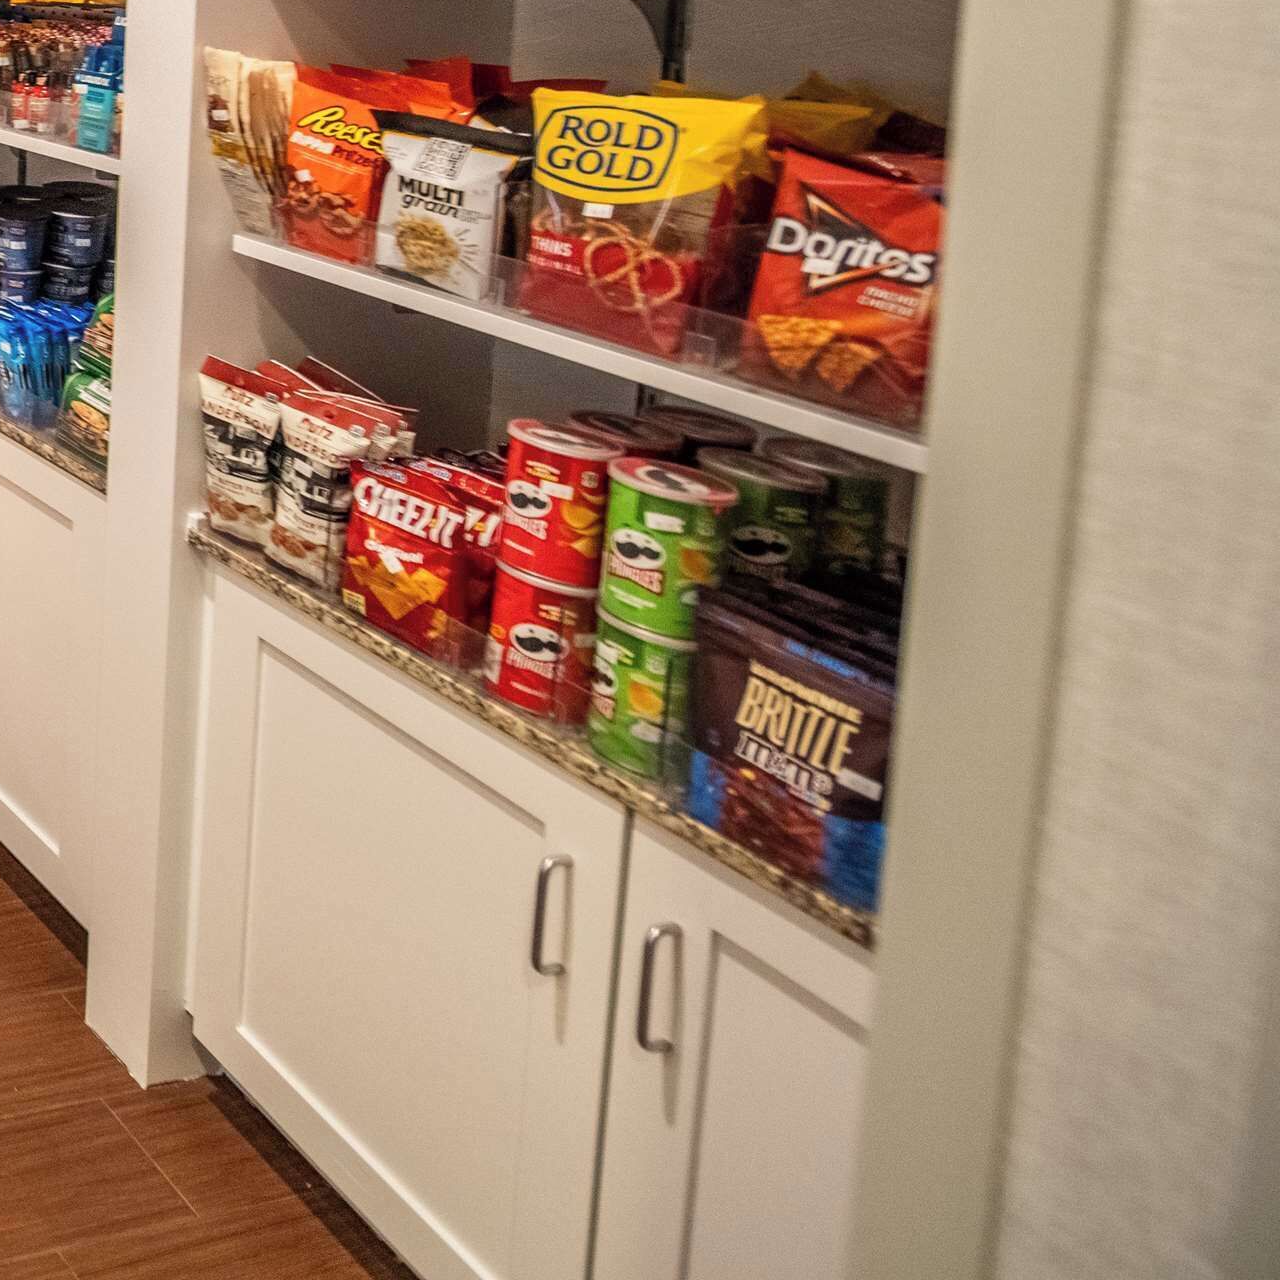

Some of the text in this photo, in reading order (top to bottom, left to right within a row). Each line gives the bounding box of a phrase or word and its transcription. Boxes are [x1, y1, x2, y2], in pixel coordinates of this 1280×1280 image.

[557, 114, 663, 151] ROLD
[547, 144, 653, 182] GOLD
[398, 175, 465, 207] MULTI
[401, 194, 460, 218] grain
[766, 216, 936, 284] Doritos
[354, 476, 465, 549] CHEEZ-IT
[735, 675, 861, 775] BRITTLE
